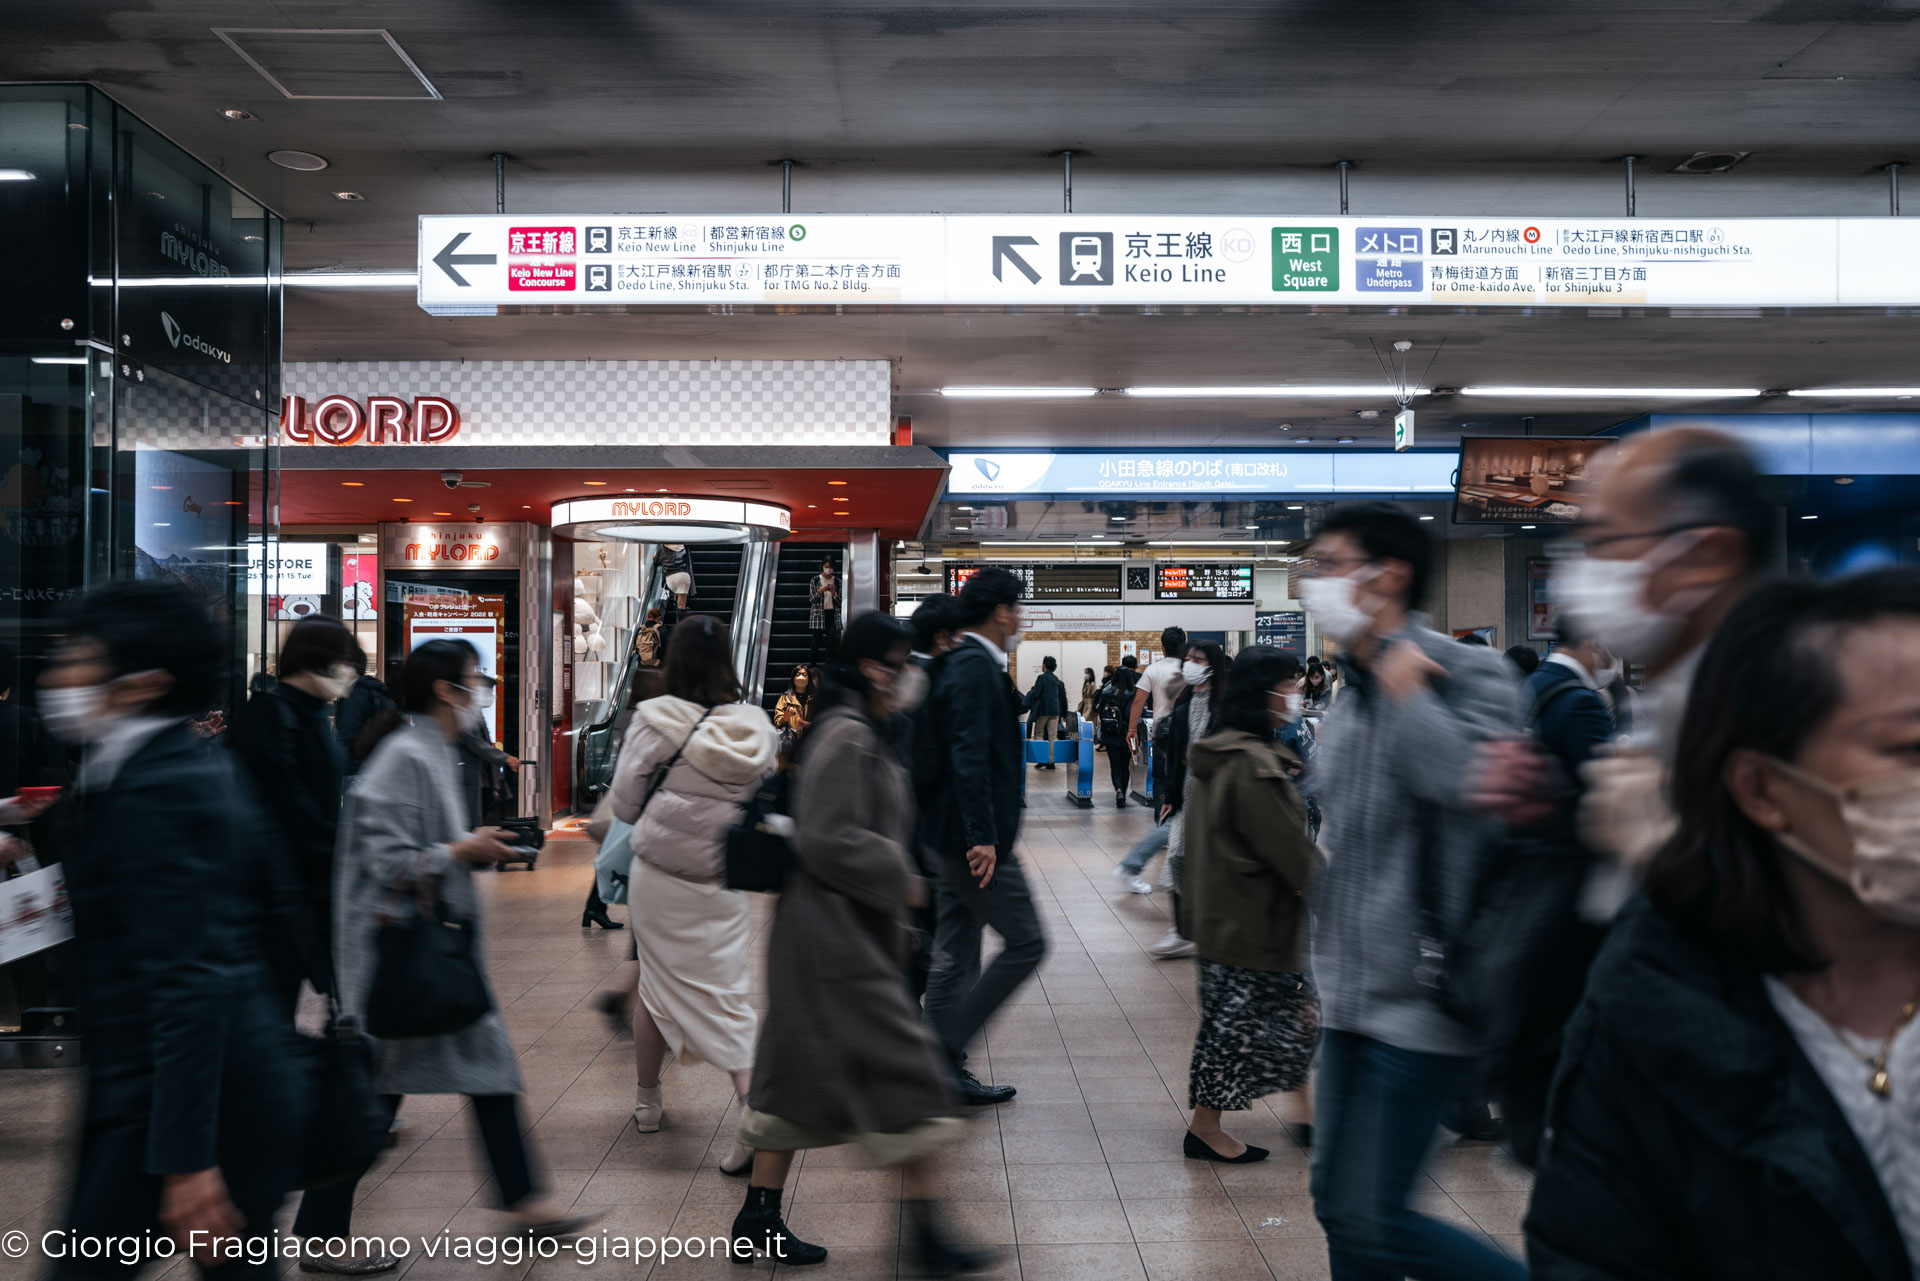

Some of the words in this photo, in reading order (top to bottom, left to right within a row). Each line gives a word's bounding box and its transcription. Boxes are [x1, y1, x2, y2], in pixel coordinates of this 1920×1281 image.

[618, 226, 677, 240] 京王新線
[710, 226, 785, 240] 都営新宿線
[1463, 228, 1520, 242] 丸ノ内線
[1571, 229, 1703, 243] 大江戸線新宿西口駅
[510, 232, 574, 254] 京王新線
[618, 242, 643, 252] Keio
[646, 242, 670, 252] New
[674, 242, 696, 252] Line
[710, 242, 758, 254] Shinjuku
[762, 242, 785, 252] Line
[1125, 232, 1213, 259] 京王線
[1281, 233, 1330, 254] 西口
[1361, 233, 1418, 253] メトロ
[1462, 245, 1528, 254] Marunouchi
[1531, 245, 1552, 254] Line
[1563, 245, 1591, 255] Oedo
[1594, 245, 1620, 256] Line,
[1622, 245, 1730, 257] Shinjuku-nishiguchi
[1732, 245, 1752, 255] Sta.
[626, 264, 732, 278] 大江戸線新宿駅
[764, 264, 900, 278] 都庁第二本庁舎方面
[1290, 258, 1322, 272] West
[511, 268, 532, 278] Keio
[533, 268, 554, 278] New
[555, 268, 574, 278] Line
[1125, 264, 1172, 282] Keio
[1182, 264, 1226, 282] Line
[1376, 268, 1402, 278] Metro
[1430, 266, 1518, 280] 青梅街道方面
[1545, 266, 1646, 280] 新宿三丁目方面
[518, 278, 566, 287] Concourse
[618, 280, 646, 290] Oedo
[650, 280, 676, 291] Line,
[678, 280, 726, 292] Shinjuku
[729, 280, 750, 290] Sta.
[764, 280, 780, 290] for
[784, 280, 810, 290] TMG
[814, 280, 838, 290] No.2
[842, 280, 871, 292] Bldg.
[1284, 274, 1328, 290] Square
[1366, 278, 1412, 289] Underpass
[1432, 282, 1447, 292] for
[1450, 282, 1510, 292] Ome-kaido
[1513, 282, 1536, 292] Ave.
[1546, 282, 1560, 292] for
[1564, 283, 1612, 295] Shinjuku
[1616, 284, 1622, 292] 3
[280, 395, 461, 446] LORD
[1099, 480, 1132, 488] ODAKYU
[1135, 480, 1151, 488] Line
[1153, 480, 1186, 488] Entrance
[612, 502, 691, 516] MYLORD
[431, 532, 482, 541] hinjuku
[405, 544, 499, 560] MYLORD
[268, 559, 312, 569] STORE
